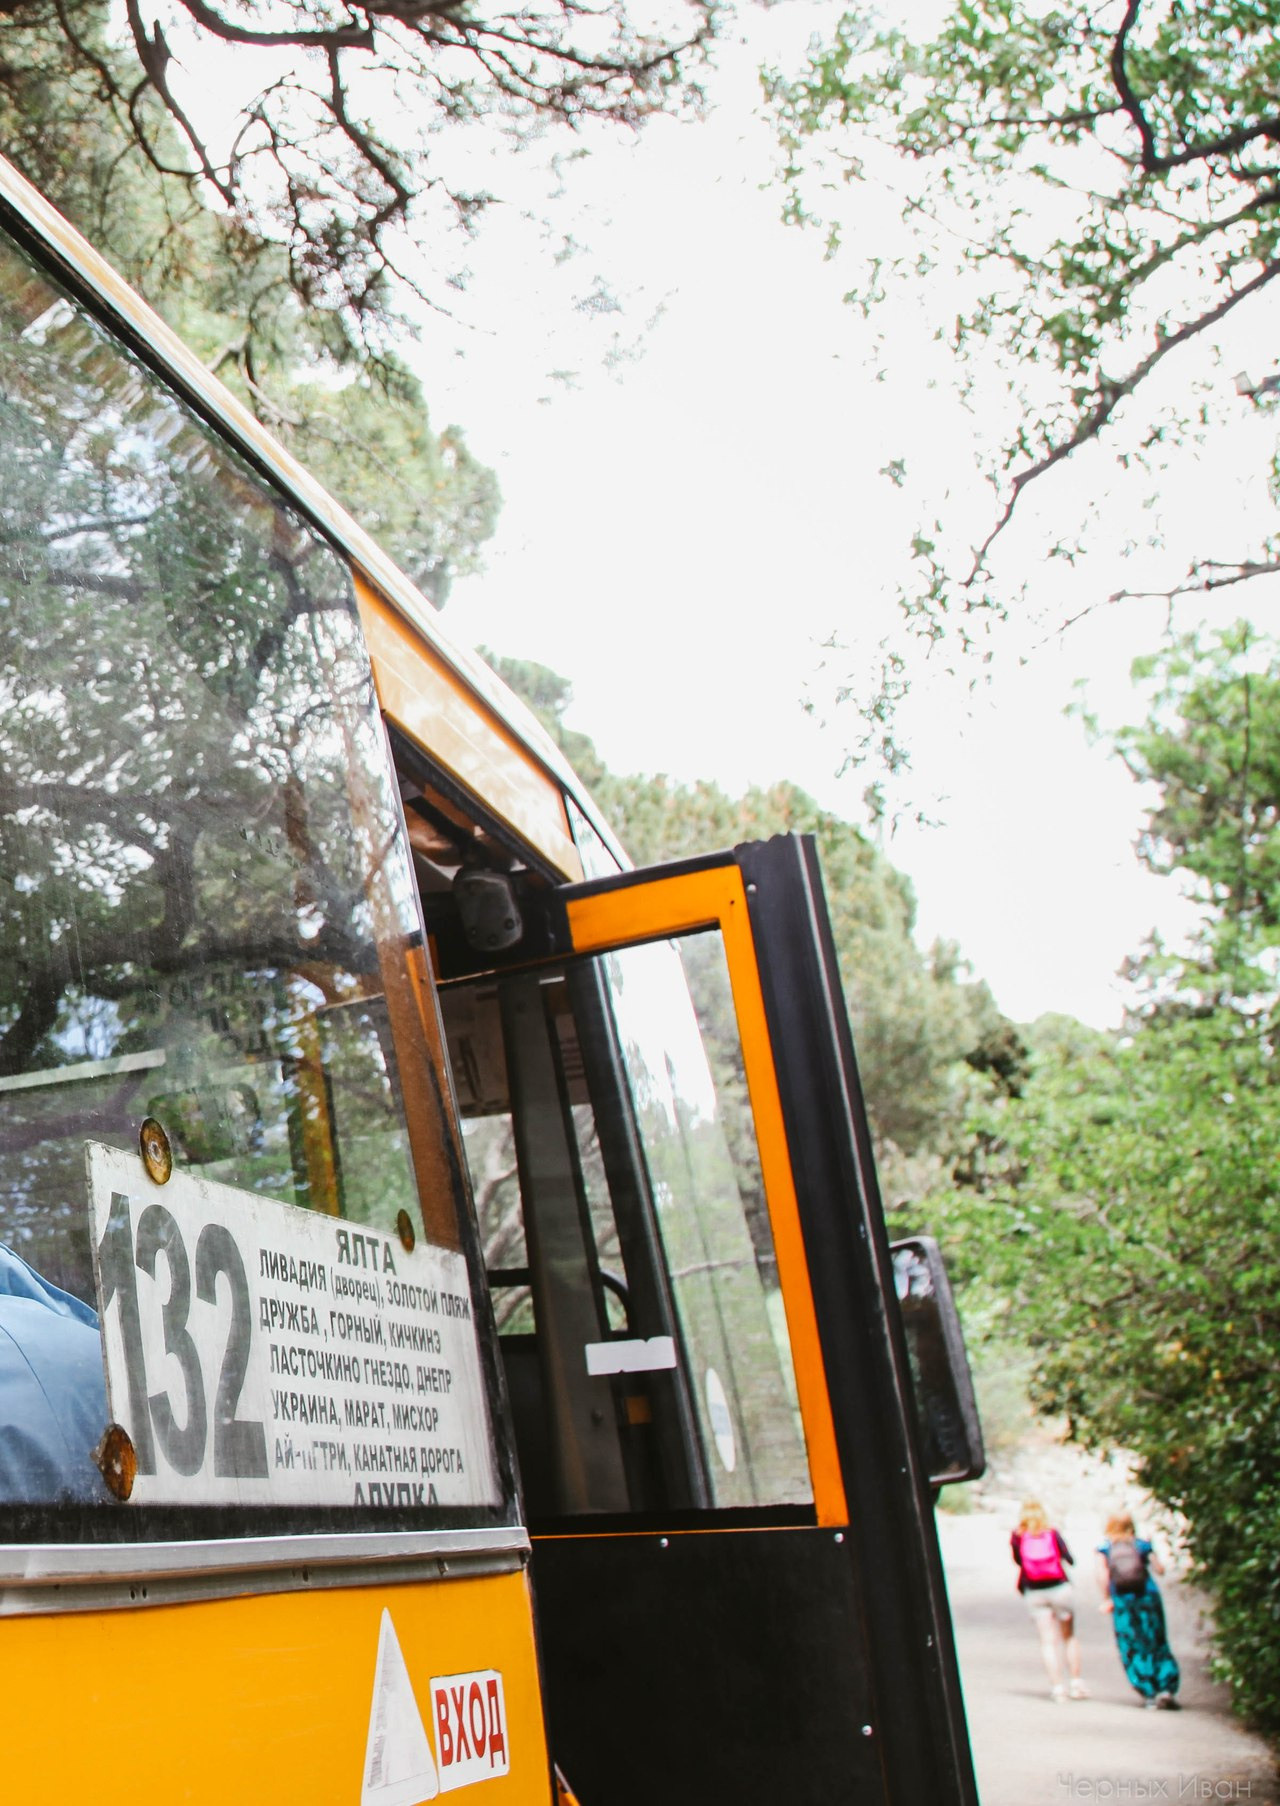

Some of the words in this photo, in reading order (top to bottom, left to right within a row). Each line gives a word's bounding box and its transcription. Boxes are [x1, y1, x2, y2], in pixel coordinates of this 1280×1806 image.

[335, 1228, 397, 1275] ЯЛТА
[259, 1248, 327, 1292] ЛИВАДИЯ
[386, 1279, 437, 1315] ЗОЛОТОЙ
[440, 1291, 471, 1321] ПЛЯЖ
[98, 1192, 270, 1479] 132
[329, 1311, 387, 1351] ГОРНЫЙ,
[388, 1321, 441, 1355] КИЧКИНЭ
[270, 1343, 360, 1384] ЛАСТОЧКИНО
[363, 1358, 415, 1395] ГНЕЗДО,
[416, 1365, 452, 1396] ДНЕПР
[270, 1389, 342, 1432] УКРАИНА,
[344, 1398, 391, 1435] МАРАТ,
[392, 1403, 439, 1432] МИСХОР
[353, 1443, 418, 1473] КАНАТНАЯ
[420, 1447, 464, 1478] ДОРОГА
[435, 1679, 506, 1769] ВХОД
